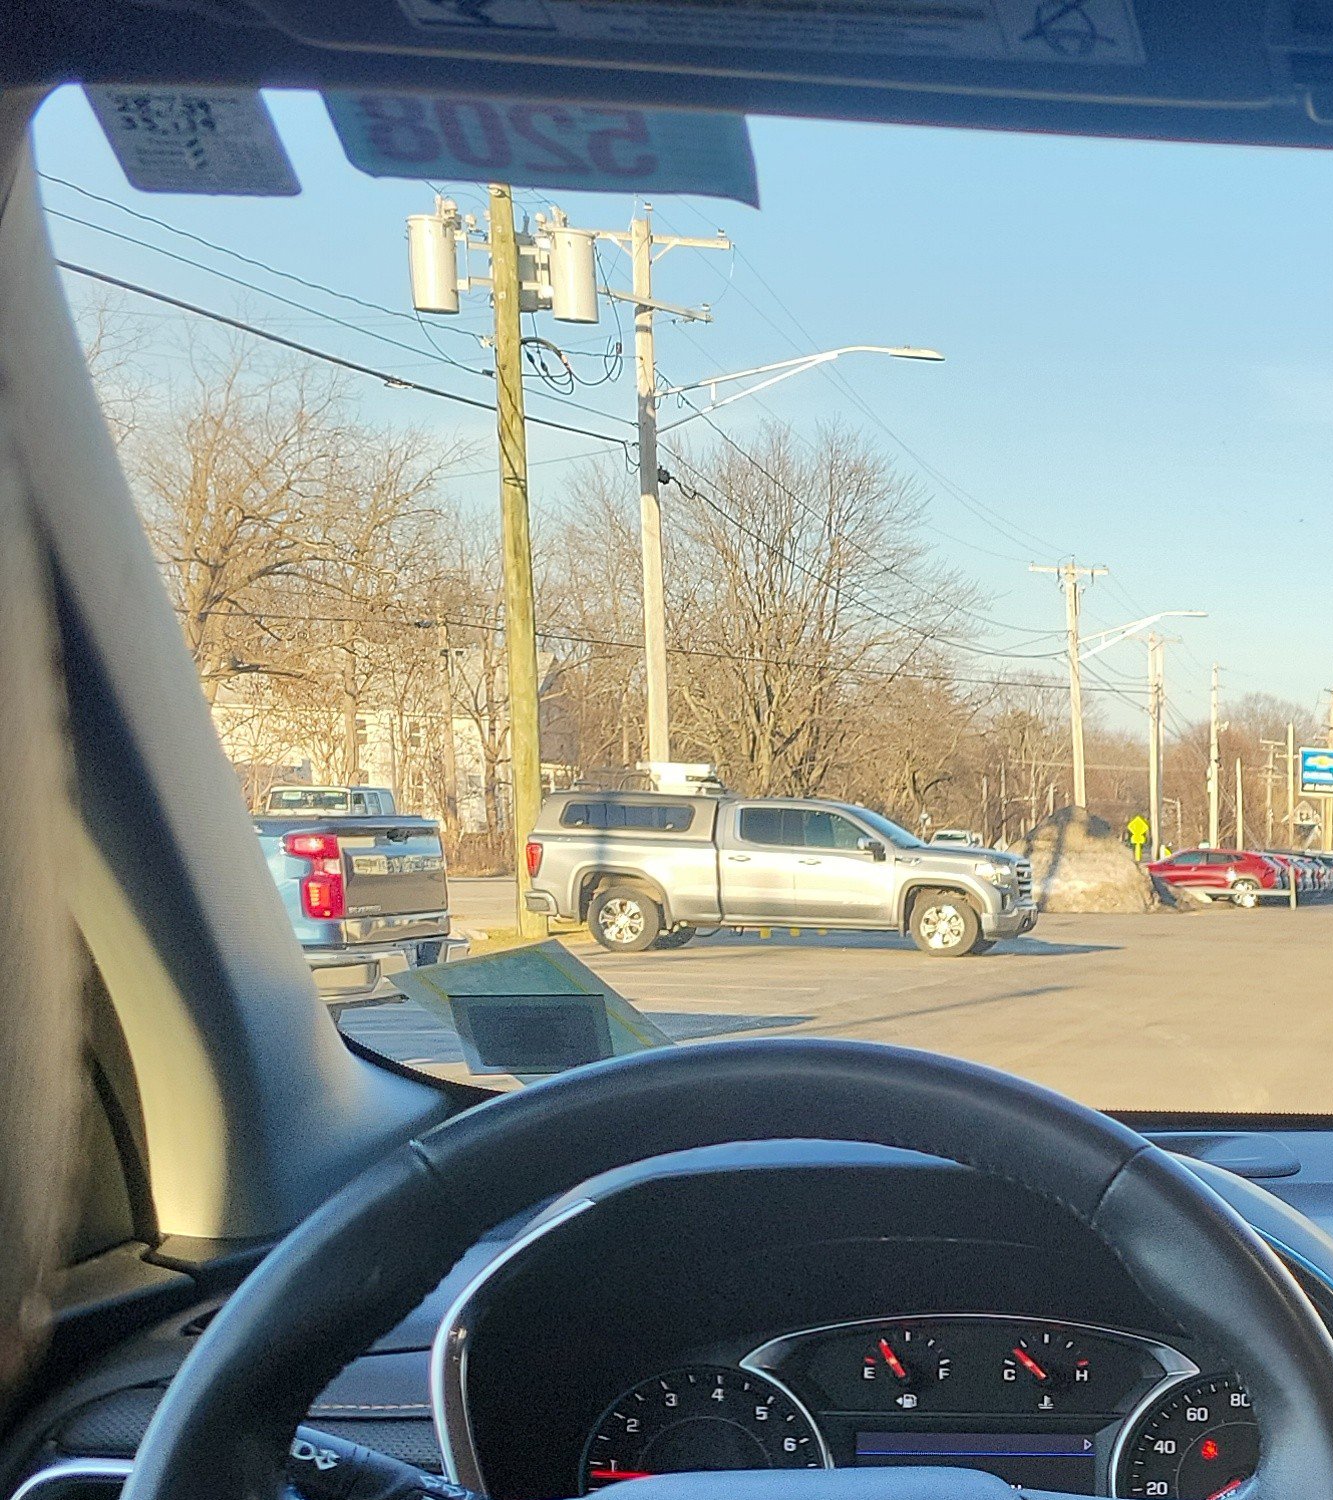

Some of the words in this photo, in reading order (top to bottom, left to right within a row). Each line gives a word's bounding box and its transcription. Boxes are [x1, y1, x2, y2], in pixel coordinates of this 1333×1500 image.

[863, 1367, 875, 1380] E
[938, 1368, 950, 1381] F
[1003, 1368, 1016, 1382] C
[1075, 1369, 1089, 1382] H
[665, 1392, 678, 1407] 3
[711, 1387, 725, 1402] 4
[755, 1406, 769, 1421] 5
[1186, 1407, 1209, 1422] 60
[626, 1418, 640, 1433] 2
[783, 1437, 797, 1452] 6
[1153, 1440, 1176, 1455] 40
[1146, 1481, 1169, 1496] 20
